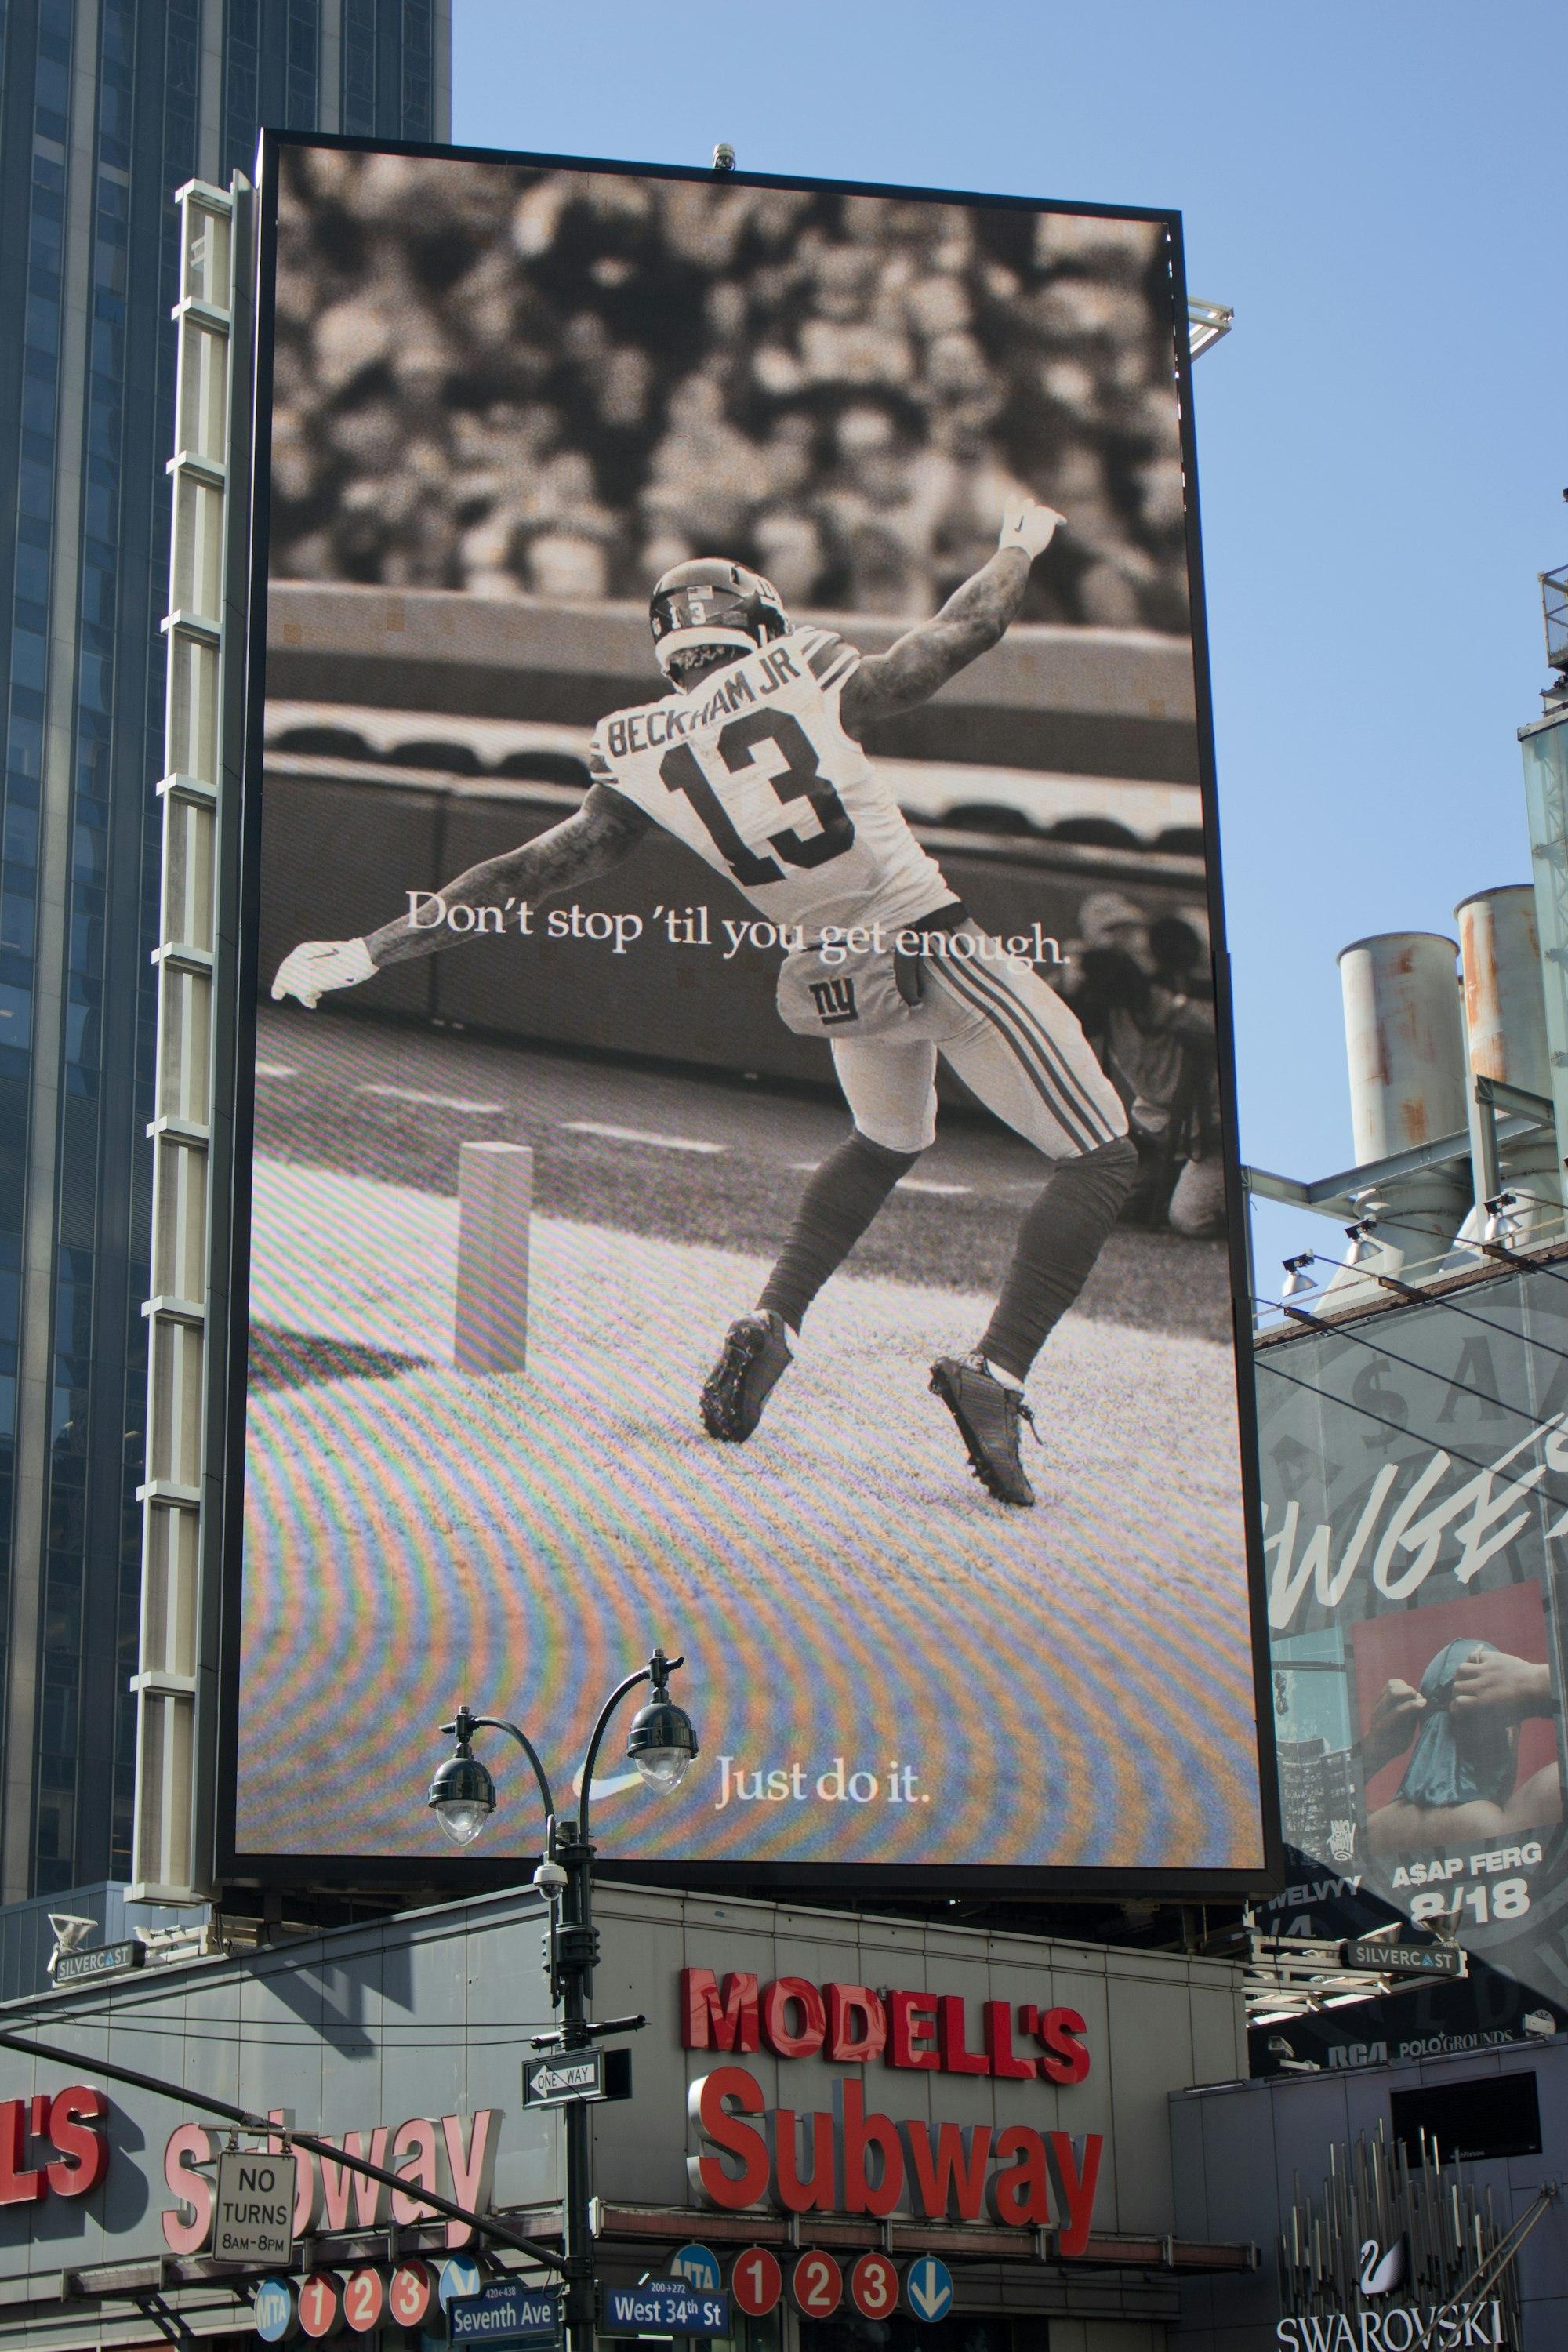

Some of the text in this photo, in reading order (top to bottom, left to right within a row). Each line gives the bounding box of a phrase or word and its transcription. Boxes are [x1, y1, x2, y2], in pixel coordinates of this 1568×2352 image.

[607, 647, 801, 758] BECKHAM JR
[659, 707, 855, 887] 13
[405, 891, 1072, 975] Don't stop 'til you get enough.
[714, 1755, 931, 1809] Just do it.
[1391, 1842, 1543, 1889] A$AP FERG
[1410, 1878, 1531, 1932] 8/18
[60, 1947, 129, 1977] SILVERCAST
[1356, 1947, 1454, 1969] SILVERCAST
[680, 1967, 1091, 2085] MODELL'S
[1328, 2028, 1514, 2067] RCA POLO GROUNDS
[538, 2067, 589, 2090] ONE WAY
[238, 2167, 275, 2193] NO
[688, 2066, 1104, 2256] Subway
[223, 2202, 288, 2226] TURNS
[222, 2232, 285, 2252] 8AM-8PM
[256, 2269, 421, 2331] MTA 1 2 3
[746, 2259, 764, 2304] 1
[806, 2261, 832, 2306] 2
[863, 2263, 888, 2308] 3
[453, 2301, 552, 2333] Seventh Ave
[615, 2296, 722, 2327] West 34th St
[1276, 2299, 1504, 2352] SWAROVSKI
